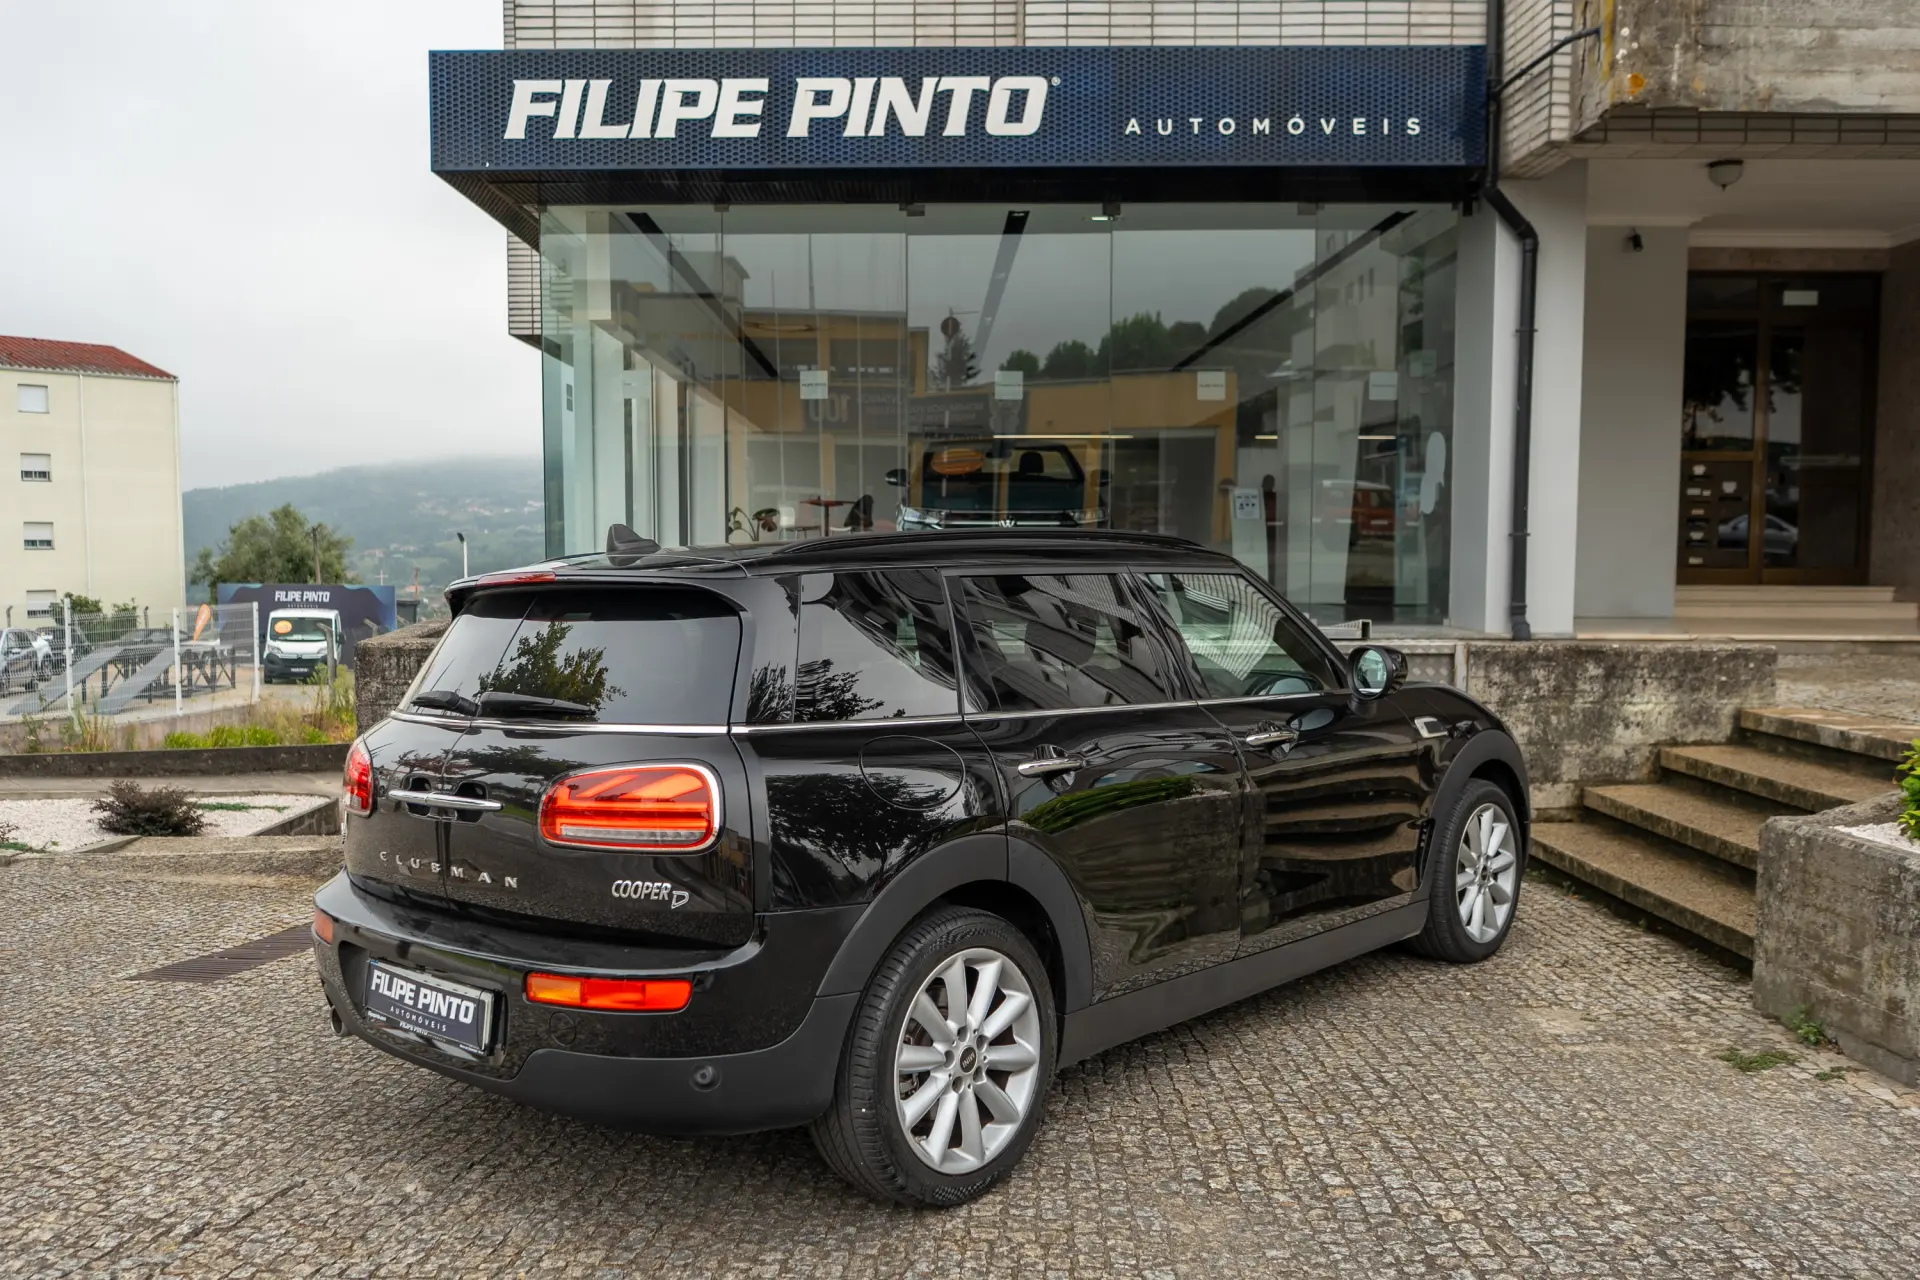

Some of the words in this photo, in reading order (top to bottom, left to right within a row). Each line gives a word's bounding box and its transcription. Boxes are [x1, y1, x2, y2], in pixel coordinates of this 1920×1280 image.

[504, 78, 769, 139] FILIPE
[786, 75, 1048, 138] PINTO
[1125, 113, 1421, 135] AUTOMÓVEIS
[275, 590, 302, 602] FILIPE
[303, 591, 330, 603] PINTO
[380, 851, 517, 888] CLUBMAN
[612, 880, 671, 901] COOPER
[671, 890, 689, 909] D
[371, 969, 416, 1006] FILIPE
[417, 987, 475, 1025] PINTO
[390, 1005, 447, 1032] AUTOMÓVEIS
[962, 1052, 975, 1068] MINI
